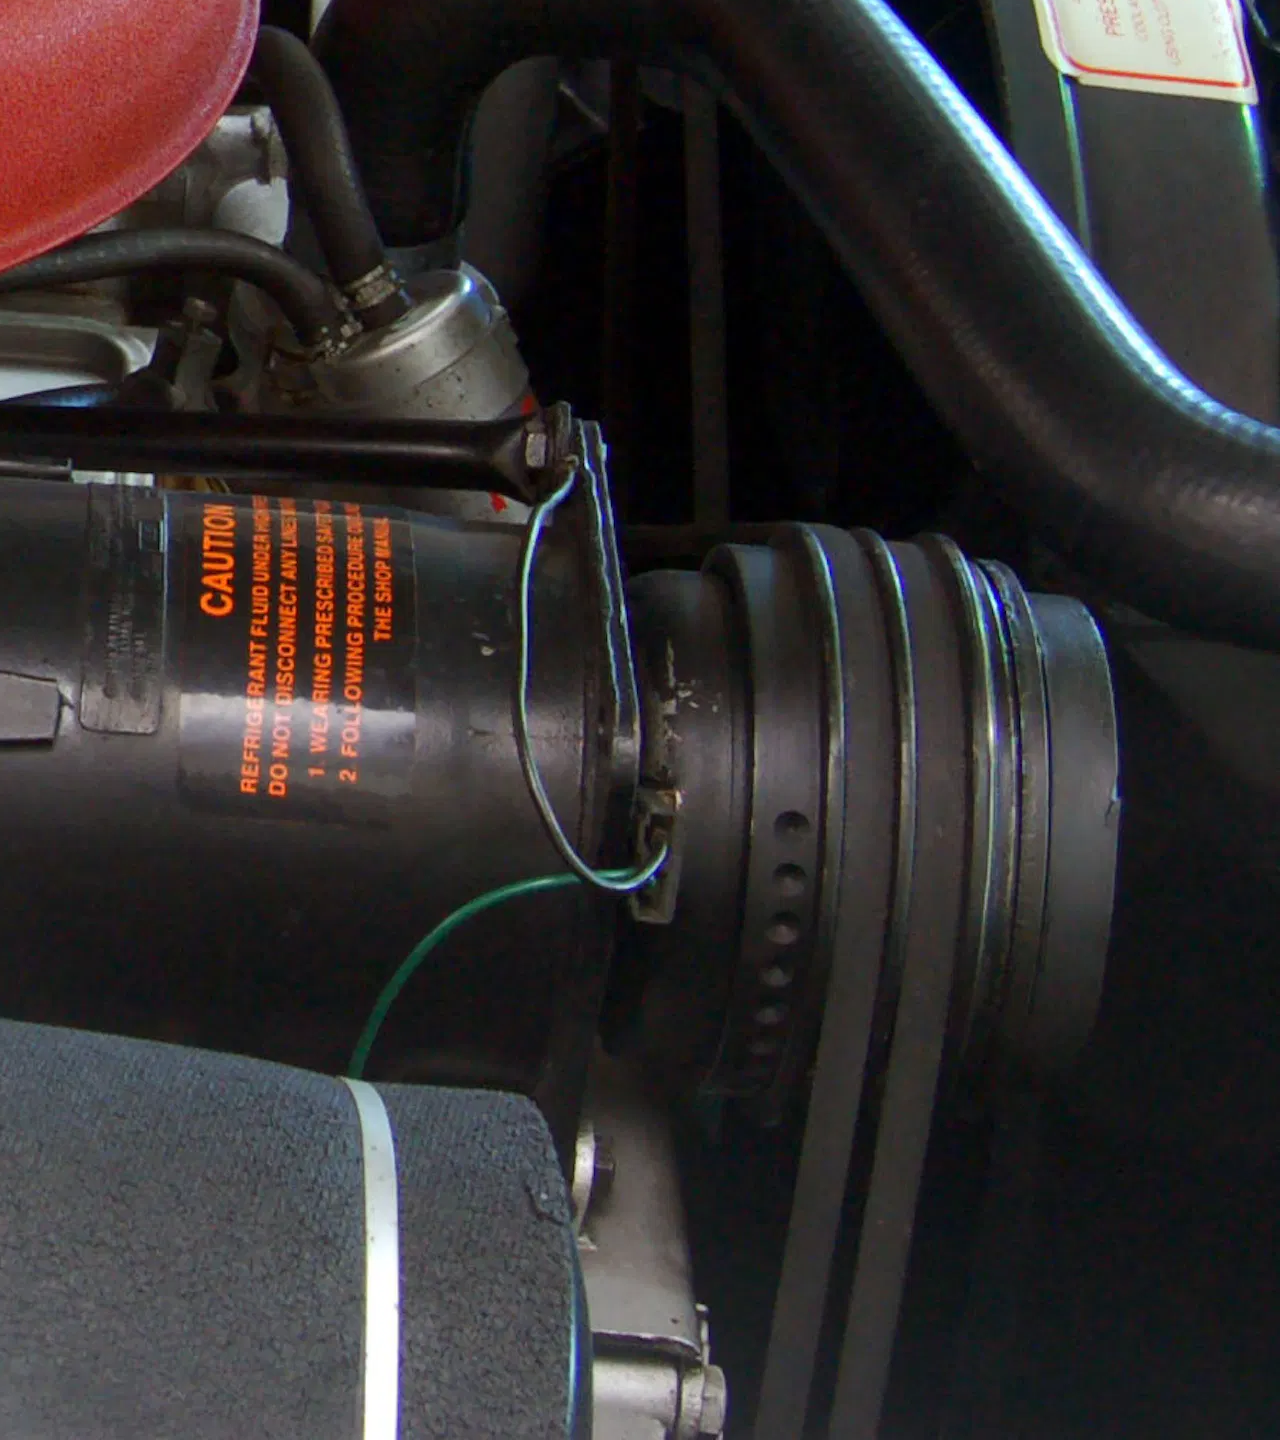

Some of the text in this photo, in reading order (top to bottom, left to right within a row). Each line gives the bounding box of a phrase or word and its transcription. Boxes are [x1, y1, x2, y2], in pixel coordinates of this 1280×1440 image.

[200, 502, 235, 616] CAUTION
[252, 535, 271, 582] UNDER
[280, 549, 297, 581] ANY
[346, 535, 366, 628] PROCEDURE
[374, 561, 392, 603] SHOP
[250, 585, 269, 637] FLUID
[314, 545, 335, 649] PRESCRIBED
[373, 607, 392, 641] THE
[275, 583, 297, 707] DISCONNECT
[241, 640, 267, 793] REFRIGERANT
[310, 653, 333, 753] WEARING
[341, 632, 364, 758] FOLLOWING
[272, 711, 292, 758] NOT
[269, 763, 288, 797] DO
